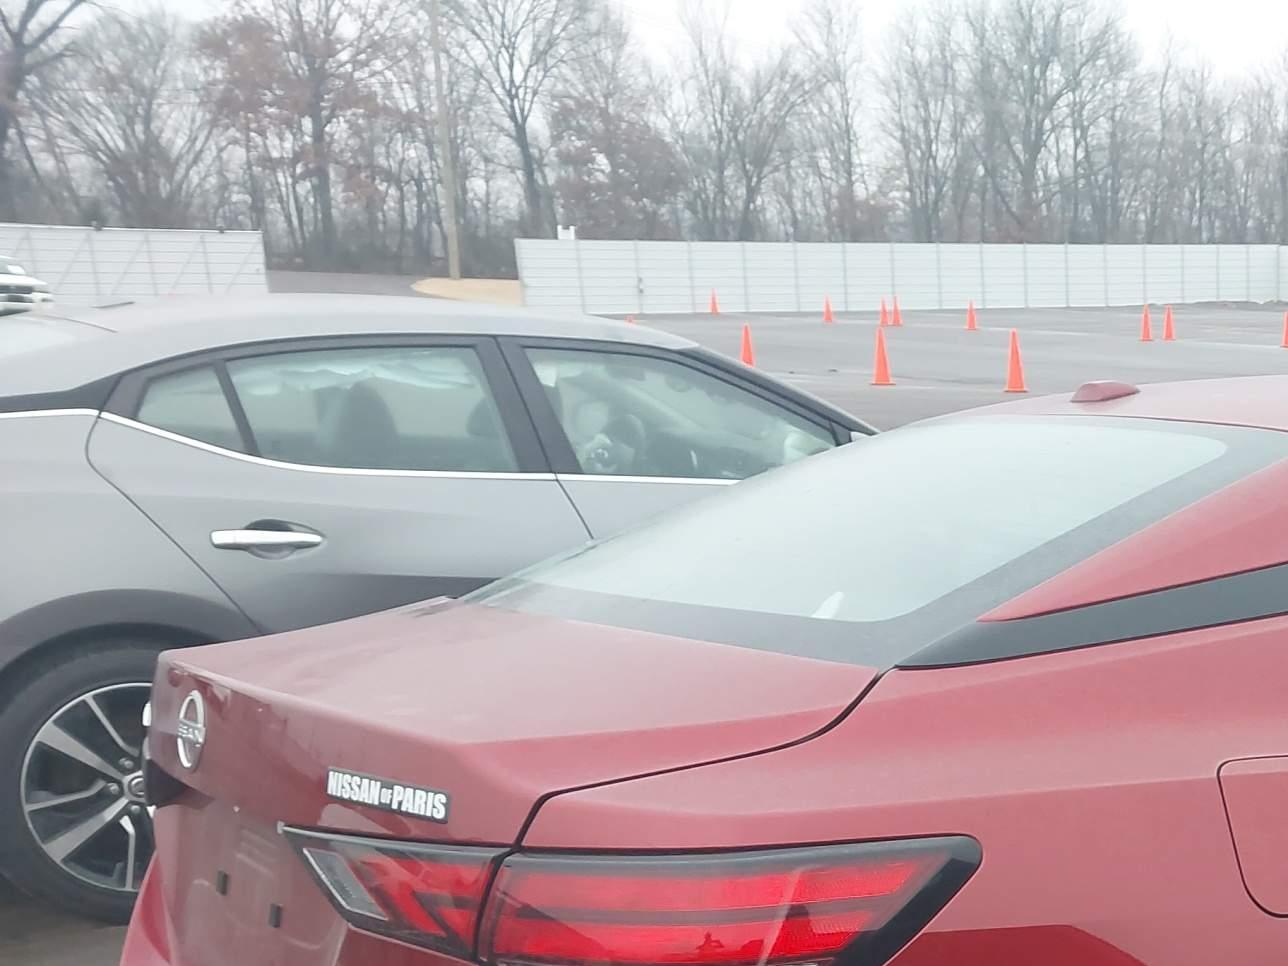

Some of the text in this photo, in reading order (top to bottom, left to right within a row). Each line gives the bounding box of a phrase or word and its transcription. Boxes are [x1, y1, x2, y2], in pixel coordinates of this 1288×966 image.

[327, 770, 447, 819] NISSAN OF PARIS
